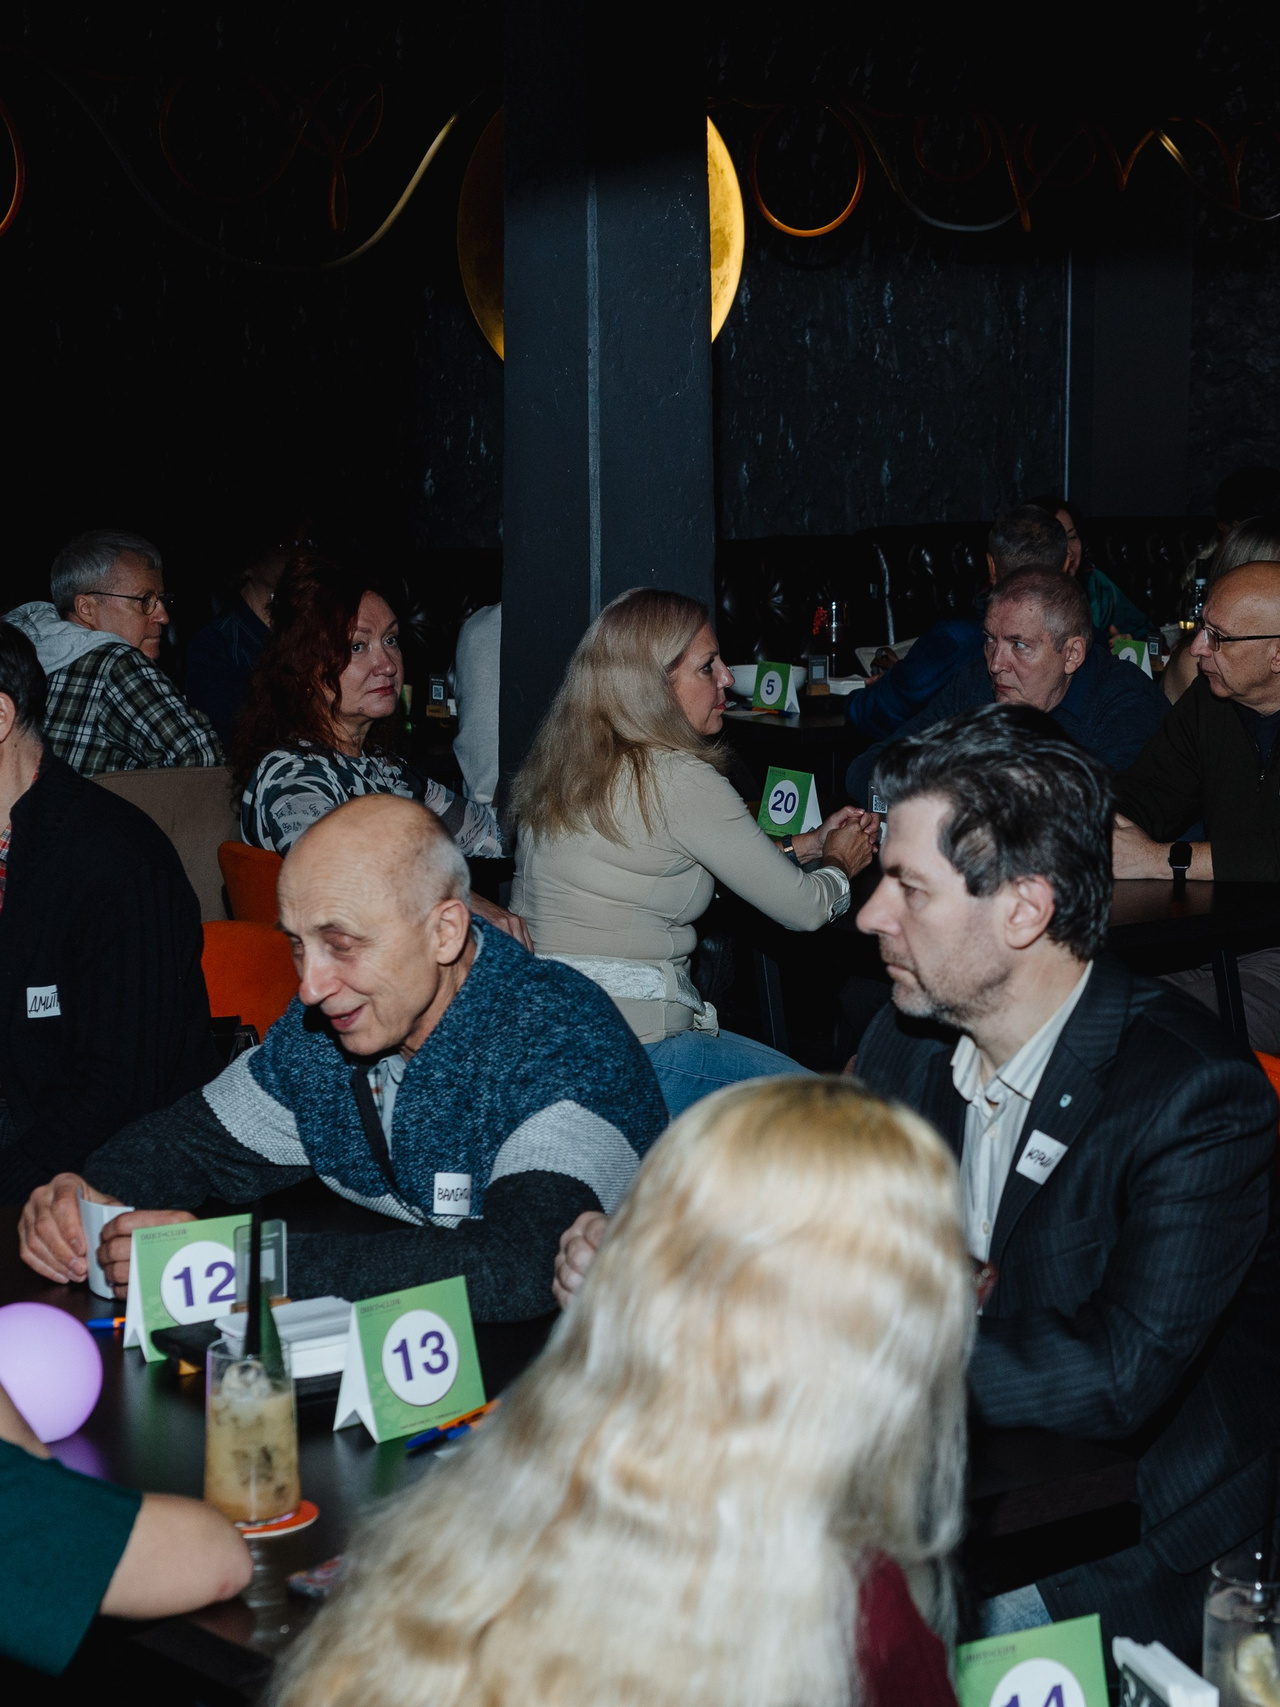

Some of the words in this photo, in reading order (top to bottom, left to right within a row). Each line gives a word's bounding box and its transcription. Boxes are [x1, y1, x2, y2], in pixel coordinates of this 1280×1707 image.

[765, 679, 775, 695] 5
[771, 790, 797, 814] 20
[172, 1261, 236, 1307] 12
[391, 1330, 449, 1382] 13
